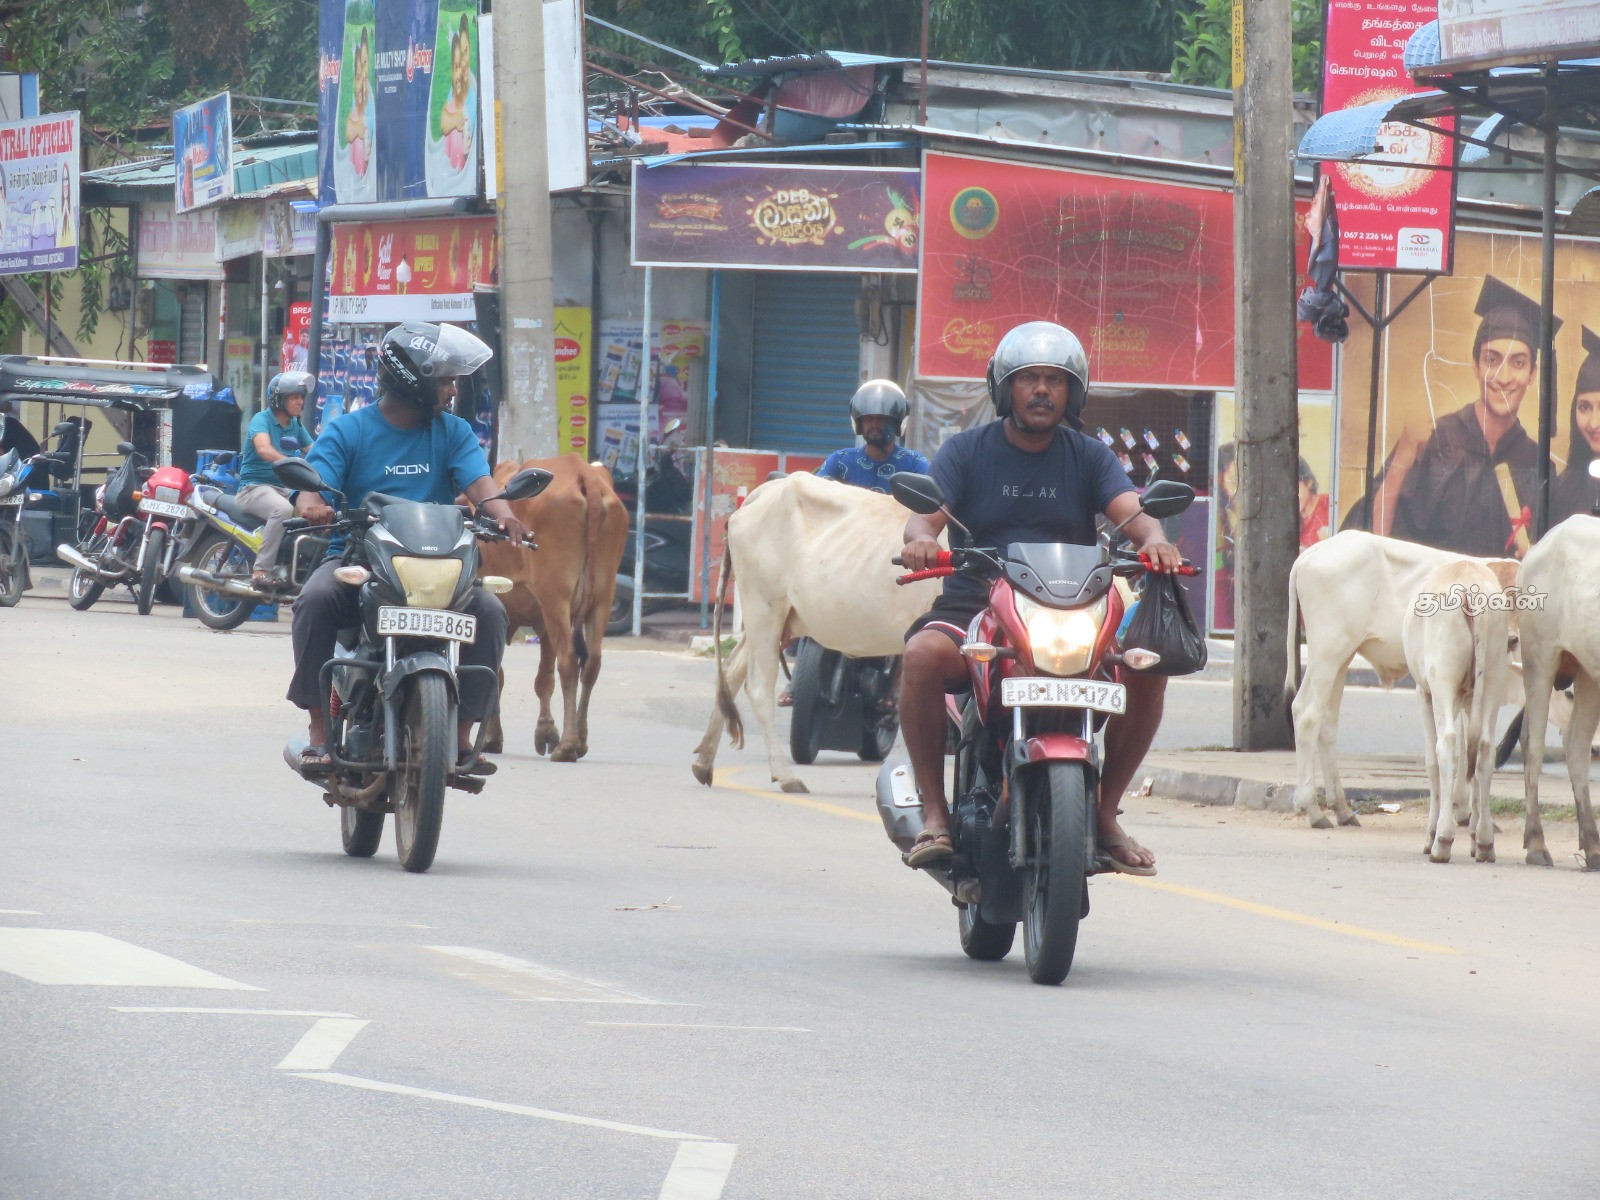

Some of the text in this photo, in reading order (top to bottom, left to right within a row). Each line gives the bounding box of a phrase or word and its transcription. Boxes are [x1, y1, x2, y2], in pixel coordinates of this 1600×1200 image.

[29, 119, 74, 157] OPTICIAN
[1343, 231, 1359, 240] 067
[1365, 232, 1379, 241] 226
[1380, 233, 1394, 241] 146
[293, 306, 312, 315] BREA
[300, 316, 312, 326] Co
[385, 463, 430, 475] MOON
[380, 618, 397, 630] EP
[1006, 690, 1026, 702] EP
